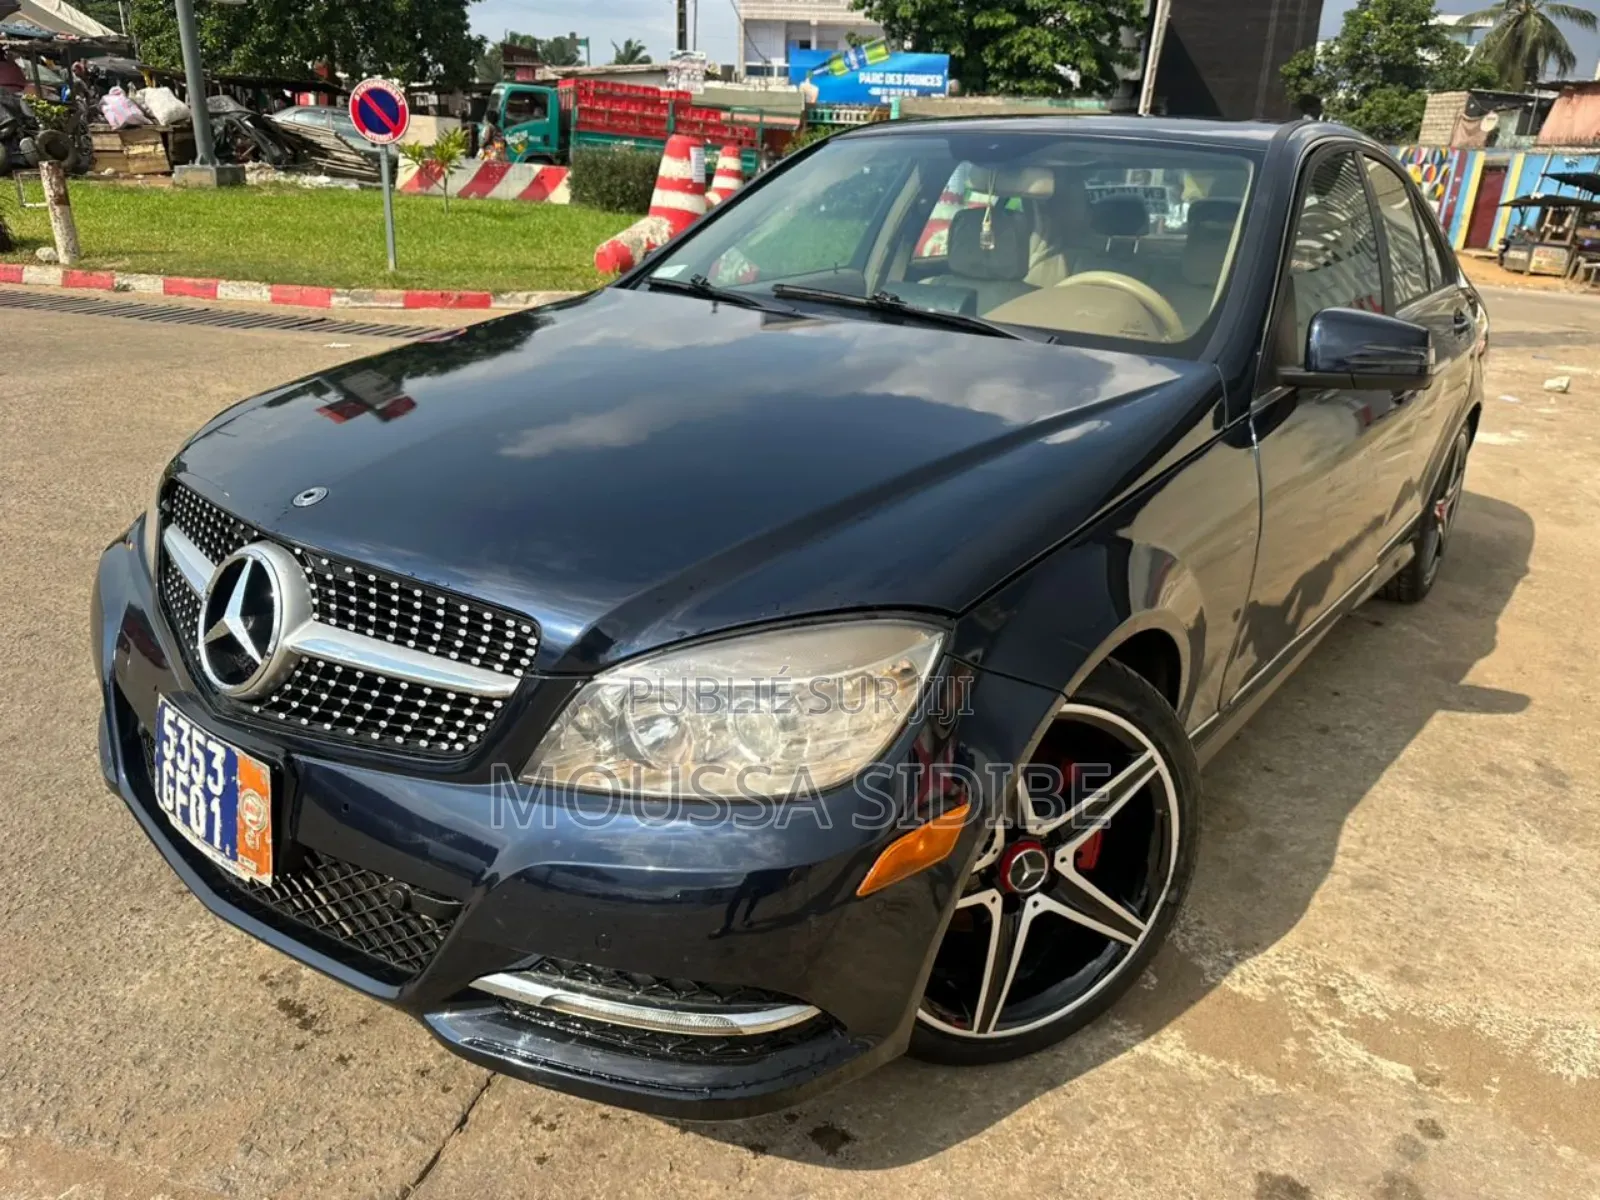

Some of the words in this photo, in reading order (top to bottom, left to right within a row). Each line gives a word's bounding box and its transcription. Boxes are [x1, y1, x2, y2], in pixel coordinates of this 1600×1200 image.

[858, 71, 884, 85] PARC
[884, 73, 903, 86] DES
[903, 73, 943, 87] PRINCES
[162, 706, 226, 796] 5353
